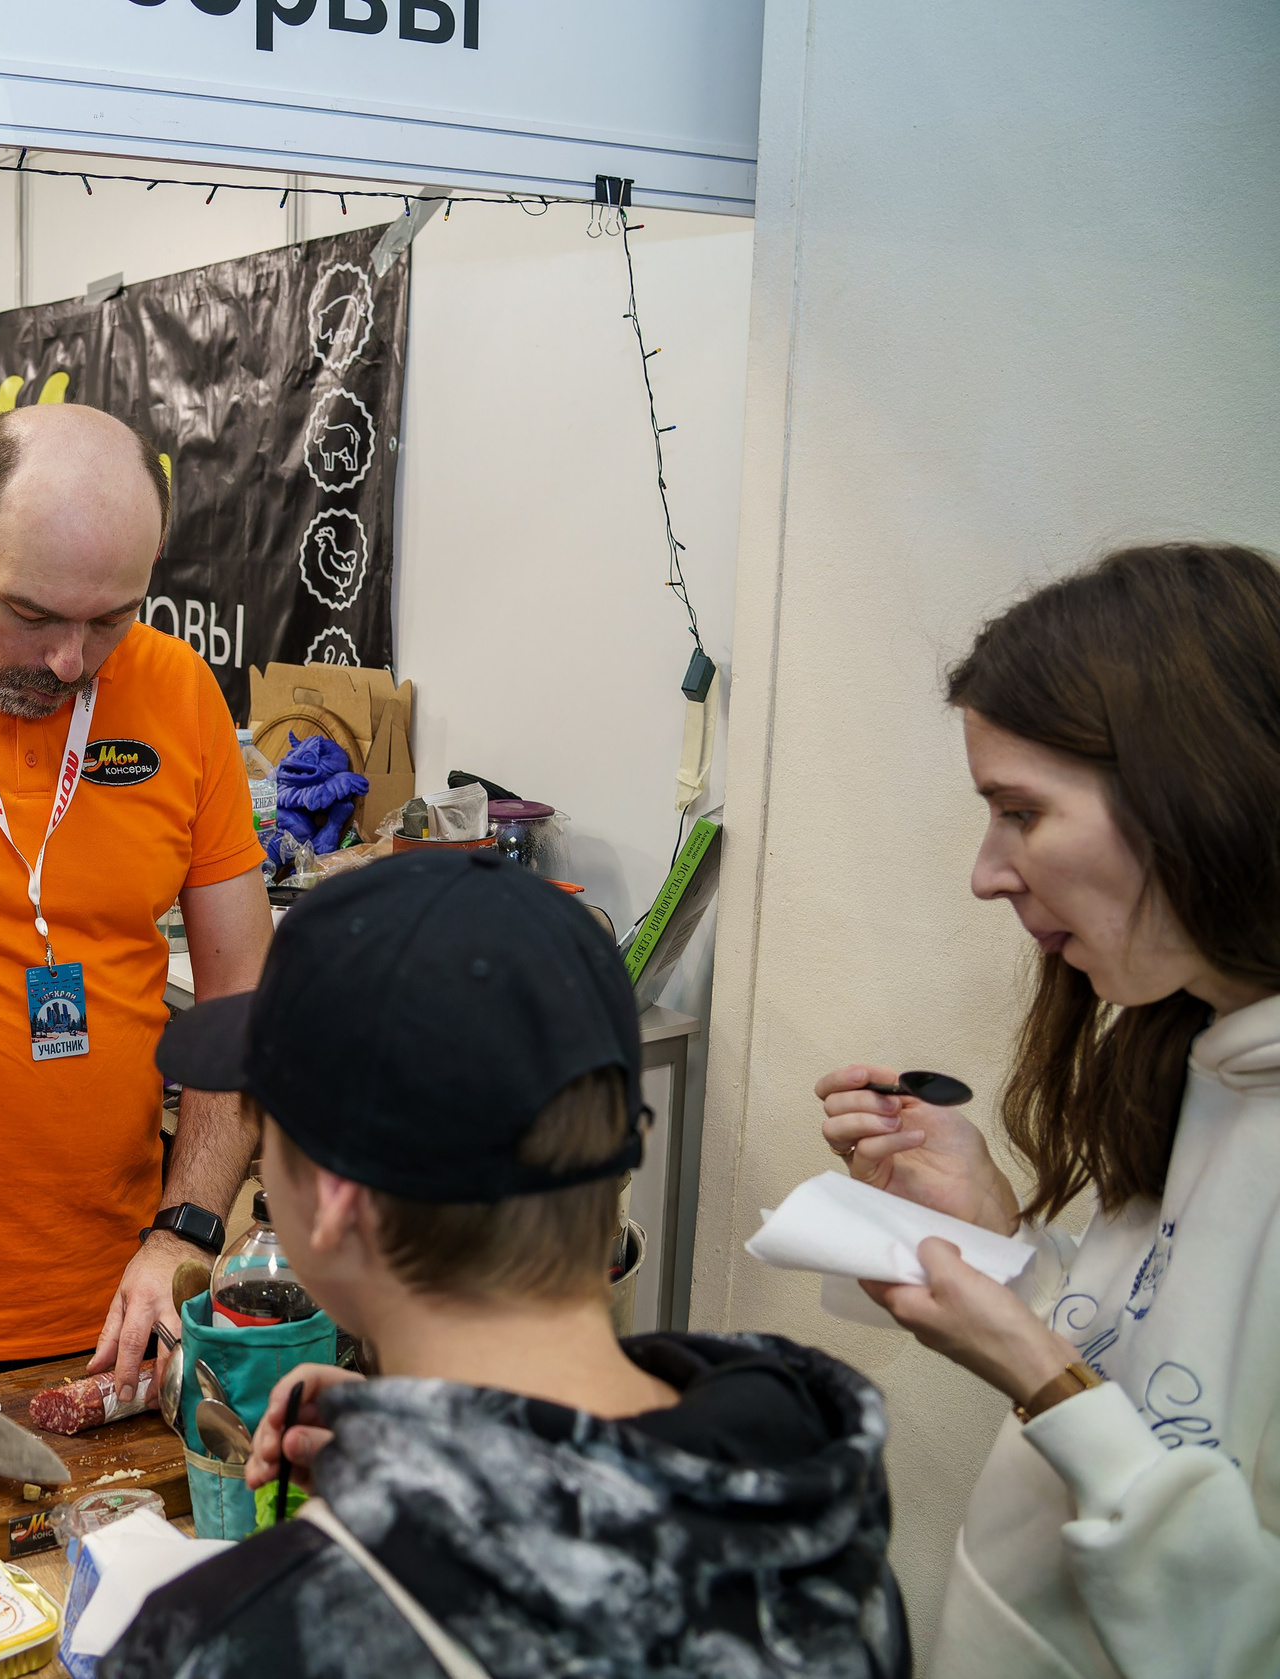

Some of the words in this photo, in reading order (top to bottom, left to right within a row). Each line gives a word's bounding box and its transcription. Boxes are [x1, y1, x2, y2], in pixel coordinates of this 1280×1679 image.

[105, 764, 153, 776] консервы
[648, 862, 691, 932] ИСЧЕЗАЮЩИЙ
[632, 933, 653, 964] СЕВЕР
[38, 1039, 84, 1056] УЧАСТНИК
